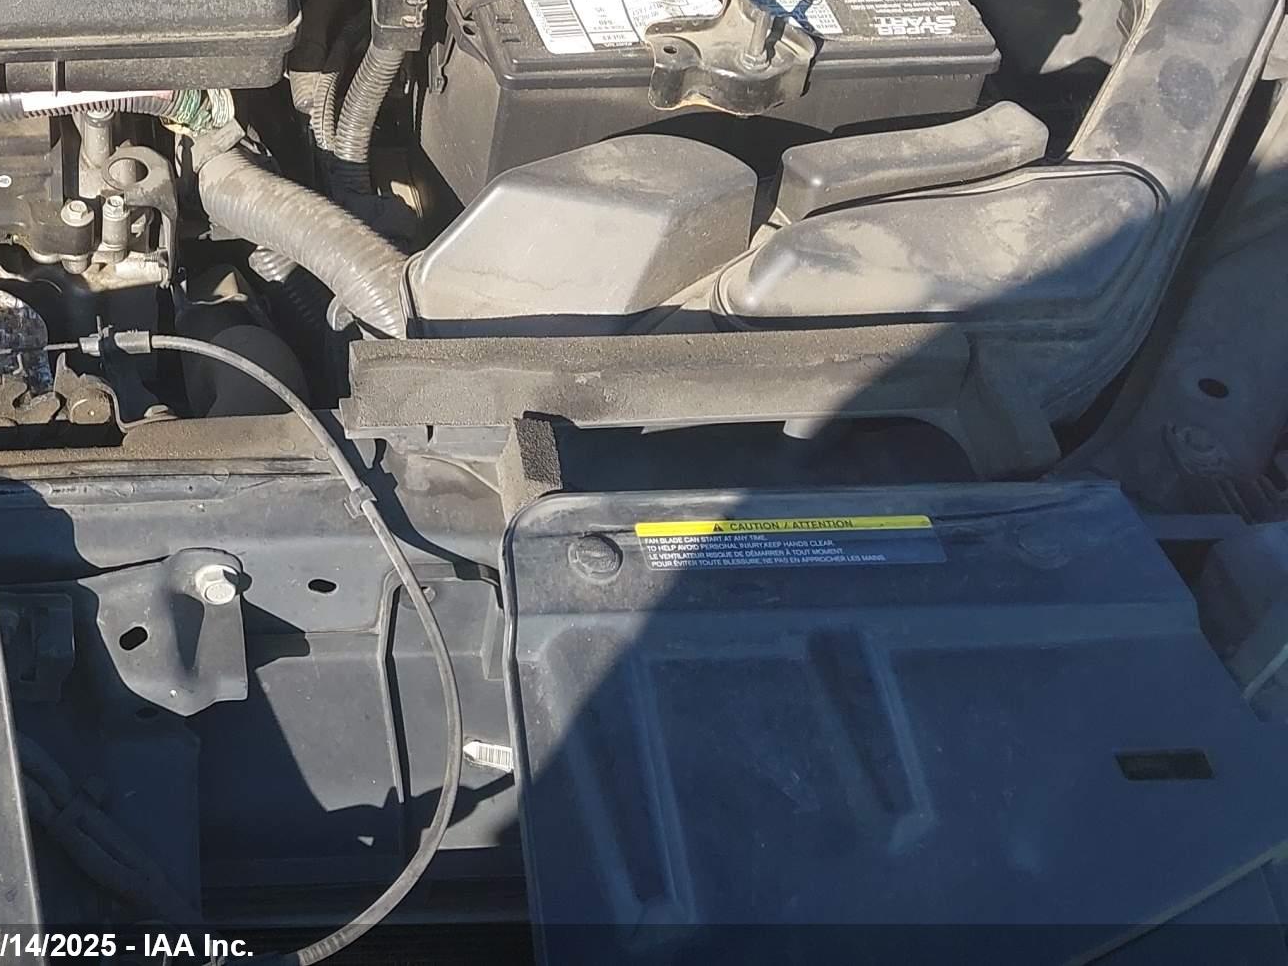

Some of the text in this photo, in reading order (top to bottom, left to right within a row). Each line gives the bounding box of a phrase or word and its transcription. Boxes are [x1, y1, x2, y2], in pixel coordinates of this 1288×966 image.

[873, 15, 957, 28] START
[877, 25, 953, 36] SUPER
[729, 521, 780, 531] CAUTION
[792, 519, 854, 530] ATTENTION
[684, 536, 700, 544] CAN
[658, 544, 676, 552] HELP
[700, 543, 738, 551] PERSONAL
[658, 552, 705, 560] VENTILATEUR
[706, 551, 733, 559] RISQUE
[745, 548, 784, 557] DÉMARRER
[793, 548, 811, 556] TOUT
[652, 560, 672, 568] POUR
[673, 559, 698, 567] ÉVITER
[763, 557, 774, 565] NE
[775, 556, 789, 564] PAS
[790, 556, 801, 564] EN
[801, 554, 846, 563] APPROCHER
[847, 554, 862, 562] LES
